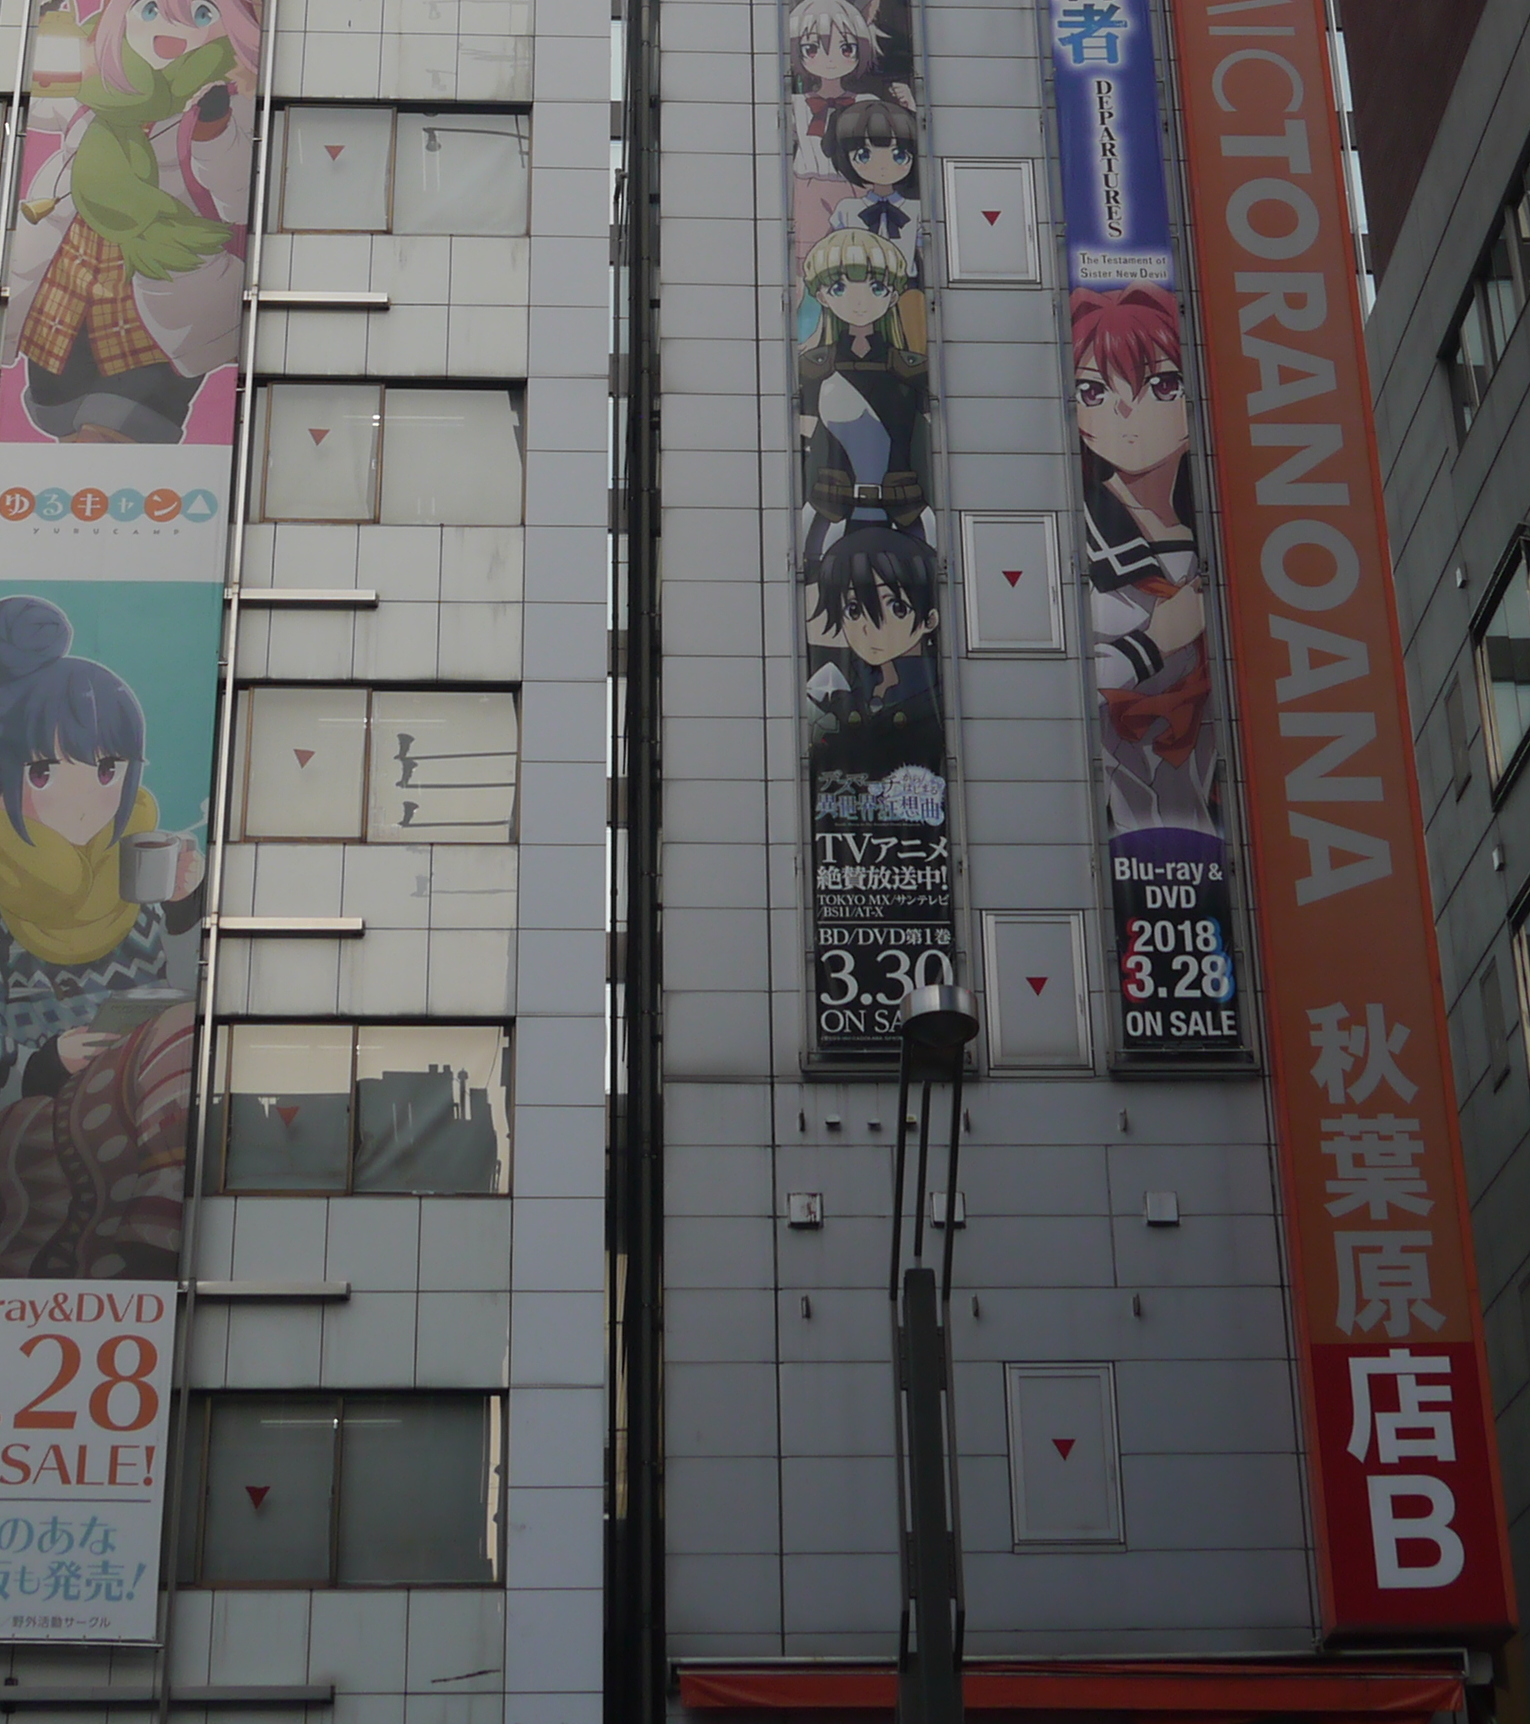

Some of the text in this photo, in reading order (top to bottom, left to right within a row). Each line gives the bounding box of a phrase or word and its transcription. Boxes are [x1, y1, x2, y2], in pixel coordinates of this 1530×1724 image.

[1095, 80, 1124, 238] DEPARTURES
[1079, 252, 1167, 266] The Testament of
[1079, 266, 1168, 280] Sister New Devil
[815, 833, 949, 864] TVアニメ
[1115, 857, 1223, 885] Blu-ray &
[817, 893, 949, 906] TOKYO MX/サンテレビ
[1146, 886, 1197, 909] DVD
[817, 906, 885, 919] /BS11/AT-X
[819, 928, 952, 946] BD/DVD第1巻
[1133, 919, 1218, 953] 2018
[820, 949, 954, 1007] 3.30
[1125, 955, 1231, 1000] 3.28
[821, 1009, 867, 1033] ON
[1126, 1010, 1238, 1038] ON SALE
